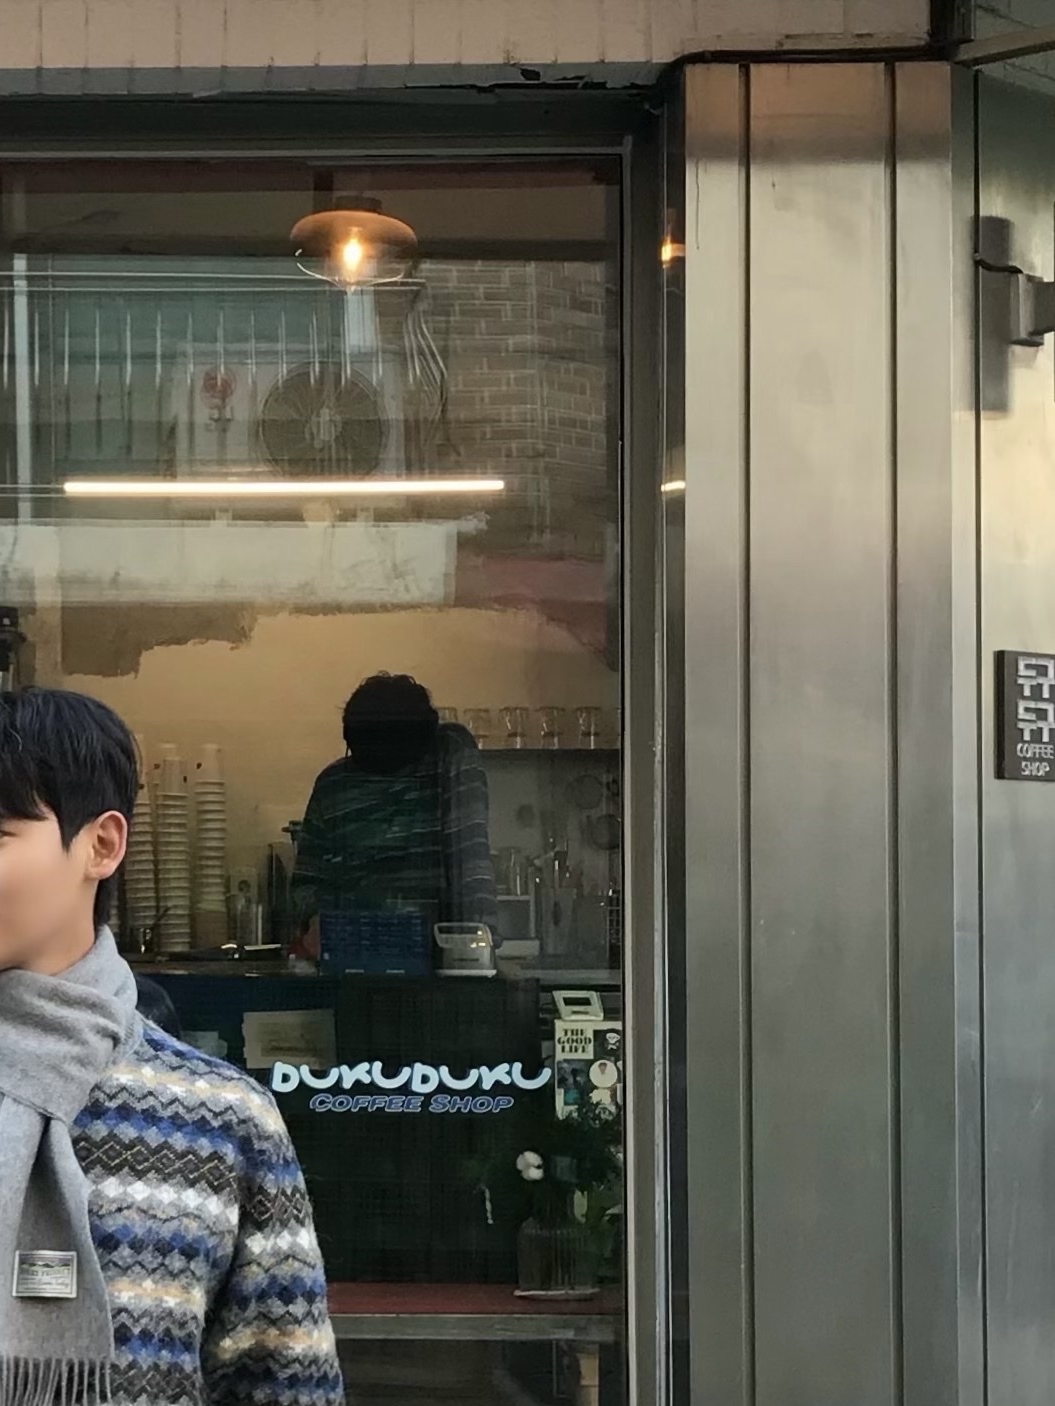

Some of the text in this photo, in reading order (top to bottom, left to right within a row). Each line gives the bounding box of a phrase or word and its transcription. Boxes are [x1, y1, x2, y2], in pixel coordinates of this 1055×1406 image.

[1016, 743, 1055, 759] COFFEE
[1021, 761, 1050, 776] SHOP
[563, 1028, 587, 1036] THE
[557, 1036, 592, 1045] GOOD
[561, 1045, 588, 1053] LIFE
[271, 1061, 553, 1093] DUKUDUKU
[309, 1093, 515, 1113] COFFEE SHOP
